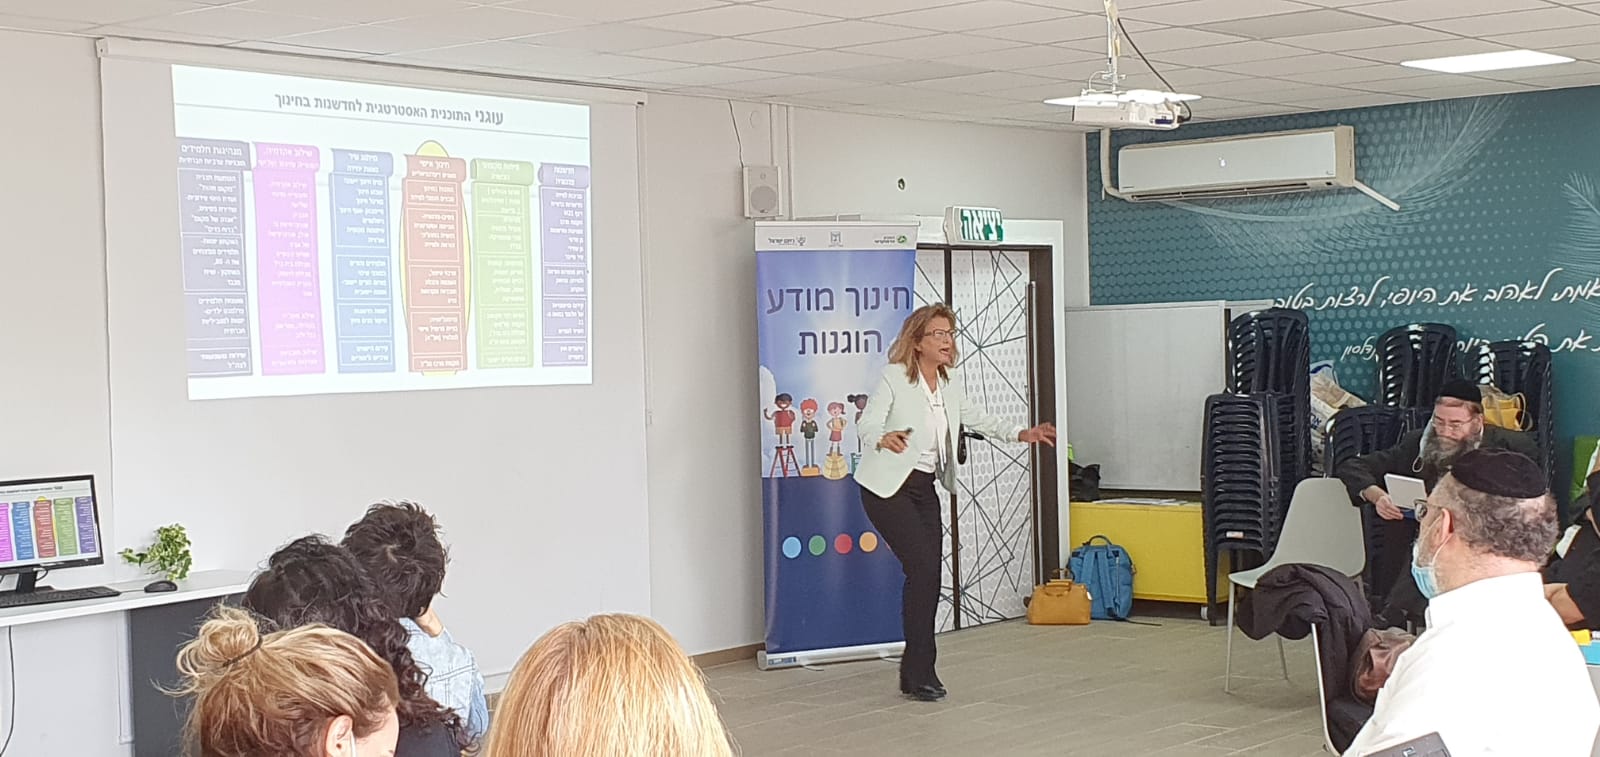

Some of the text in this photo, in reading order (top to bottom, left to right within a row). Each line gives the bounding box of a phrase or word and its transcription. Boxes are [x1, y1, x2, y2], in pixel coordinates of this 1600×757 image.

[274, 93, 504, 126] עוגני התוכנית האסטרטגית לחדשנות בחינוך
[181, 144, 242, 156] מנהיגות תלמידים
[419, 160, 450, 170] חינוך אישי
[961, 208, 1002, 241] יציאה
[1315, 276, 1391, 311] לרצות
[1437, 282, 1479, 306] את
[1483, 267, 1563, 303] לאהוב
[766, 286, 910, 317] חינוך מודע
[798, 330, 882, 355] הוגנות
[1550, 329, 1593, 353] את
